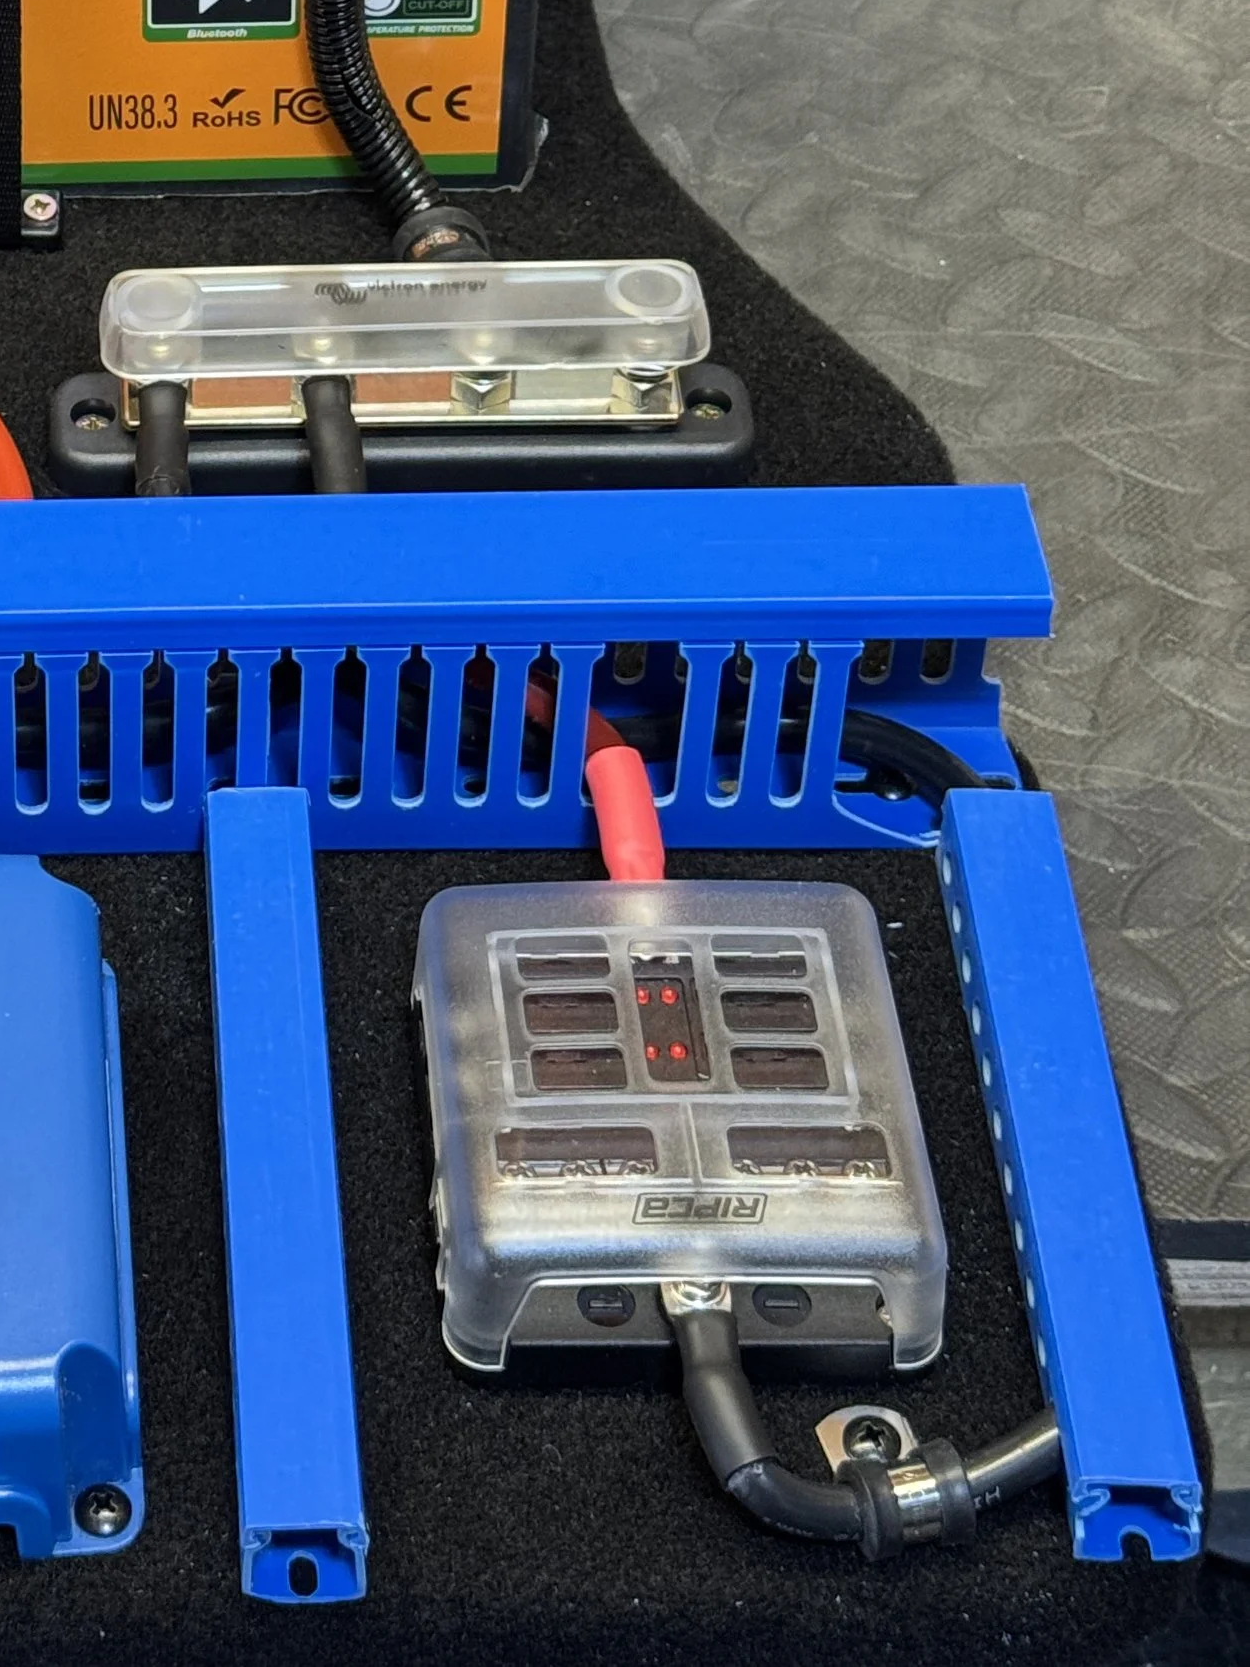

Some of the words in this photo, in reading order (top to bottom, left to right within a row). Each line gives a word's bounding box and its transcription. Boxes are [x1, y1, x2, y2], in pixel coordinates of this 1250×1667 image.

[408, 0, 465, 10] CUT-OFF
[187, 28, 248, 39] Bluetooth
[418, 25, 474, 34] PROTECTION
[405, 85, 473, 122] CE
[88, 93, 178, 131] UN38.3
[192, 110, 261, 128] RoHS
